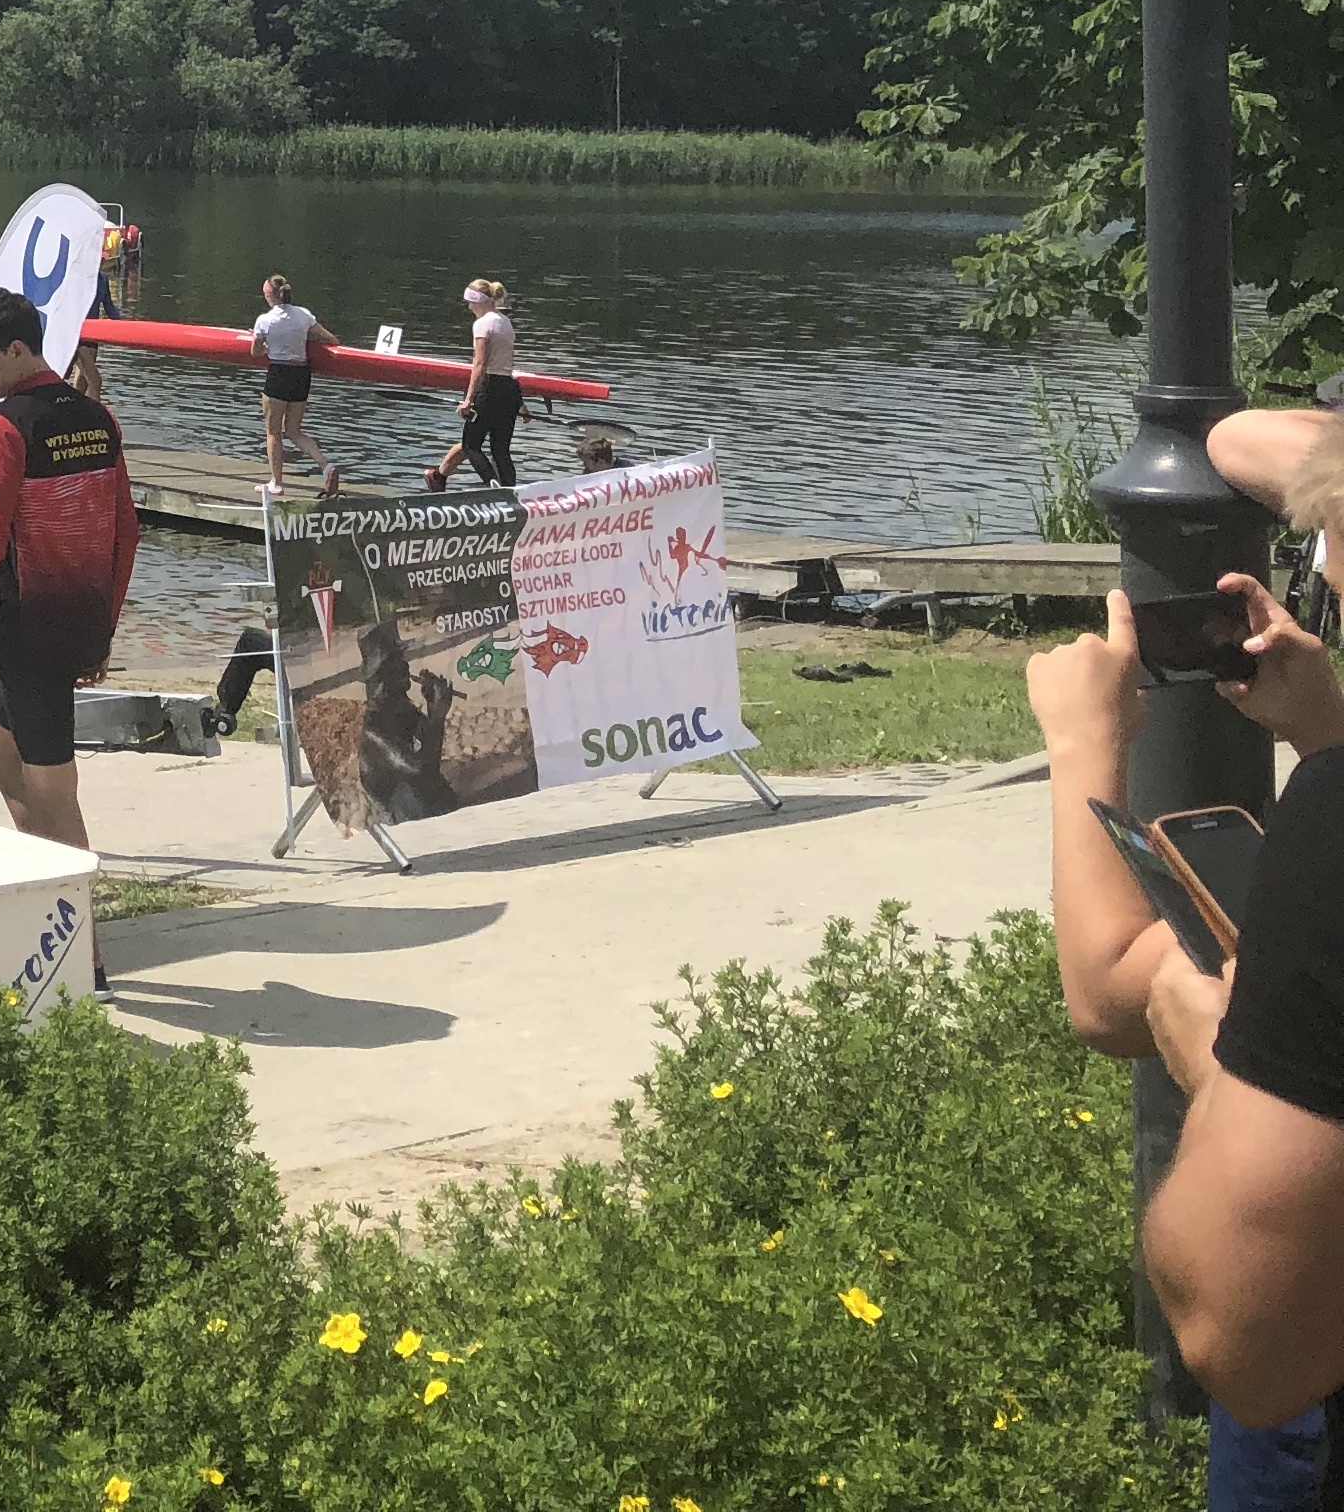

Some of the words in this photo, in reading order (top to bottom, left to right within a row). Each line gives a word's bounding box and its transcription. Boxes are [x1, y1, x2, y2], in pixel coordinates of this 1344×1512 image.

[382, 329, 394, 348] 4
[45, 434, 70, 448] WTS
[273, 500, 517, 544] MIĘDZYNARODOWE
[521, 483, 612, 519] REGATY
[364, 543, 381, 570] O
[387, 531, 513, 567] MEMORIAŁ
[517, 520, 576, 549] JANA
[581, 506, 654, 539] RAABE
[407, 558, 510, 588] PRZECIĄGANIE
[512, 550, 577, 573] SMOCZEJ
[580, 542, 623, 562] ŁODZI
[499, 581, 511, 598] O
[514, 572, 573, 596] PUCHAR
[436, 605, 510, 634] STAROSTY
[519, 587, 626, 620] SZTUMSKIEGO
[581, 706, 724, 768] sonac
